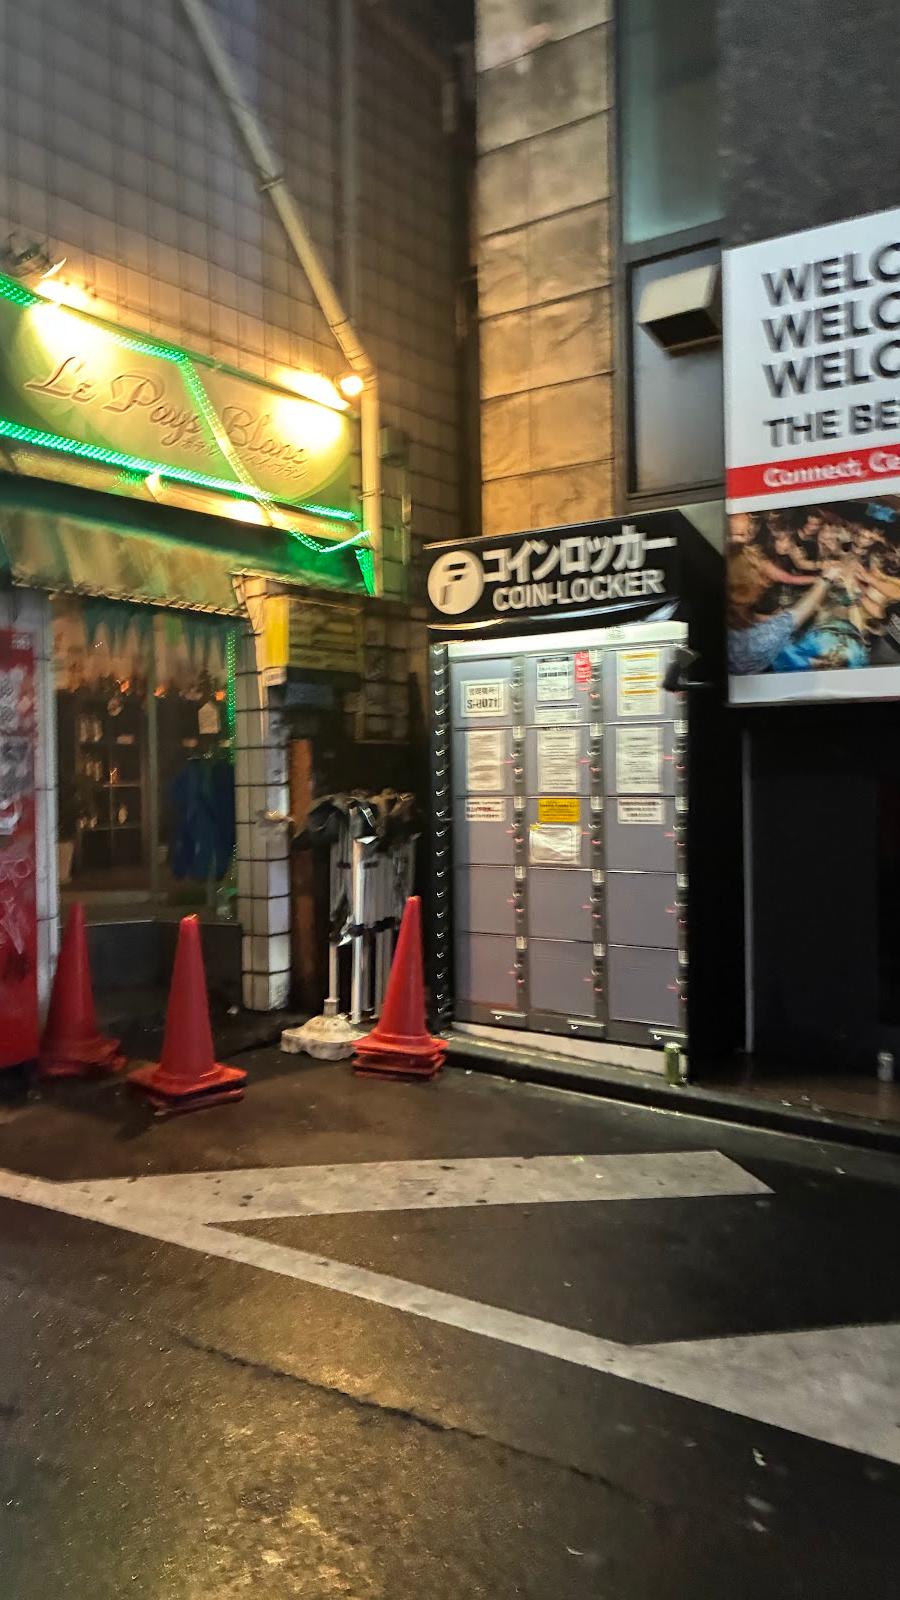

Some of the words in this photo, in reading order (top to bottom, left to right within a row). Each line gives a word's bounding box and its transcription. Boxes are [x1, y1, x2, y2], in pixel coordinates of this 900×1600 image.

[24, 357, 96, 403] Le
[764, 409, 842, 448] THE
[483, 525, 677, 583] コインロッカー
[492, 569, 666, 612] COIN-LOCKER
